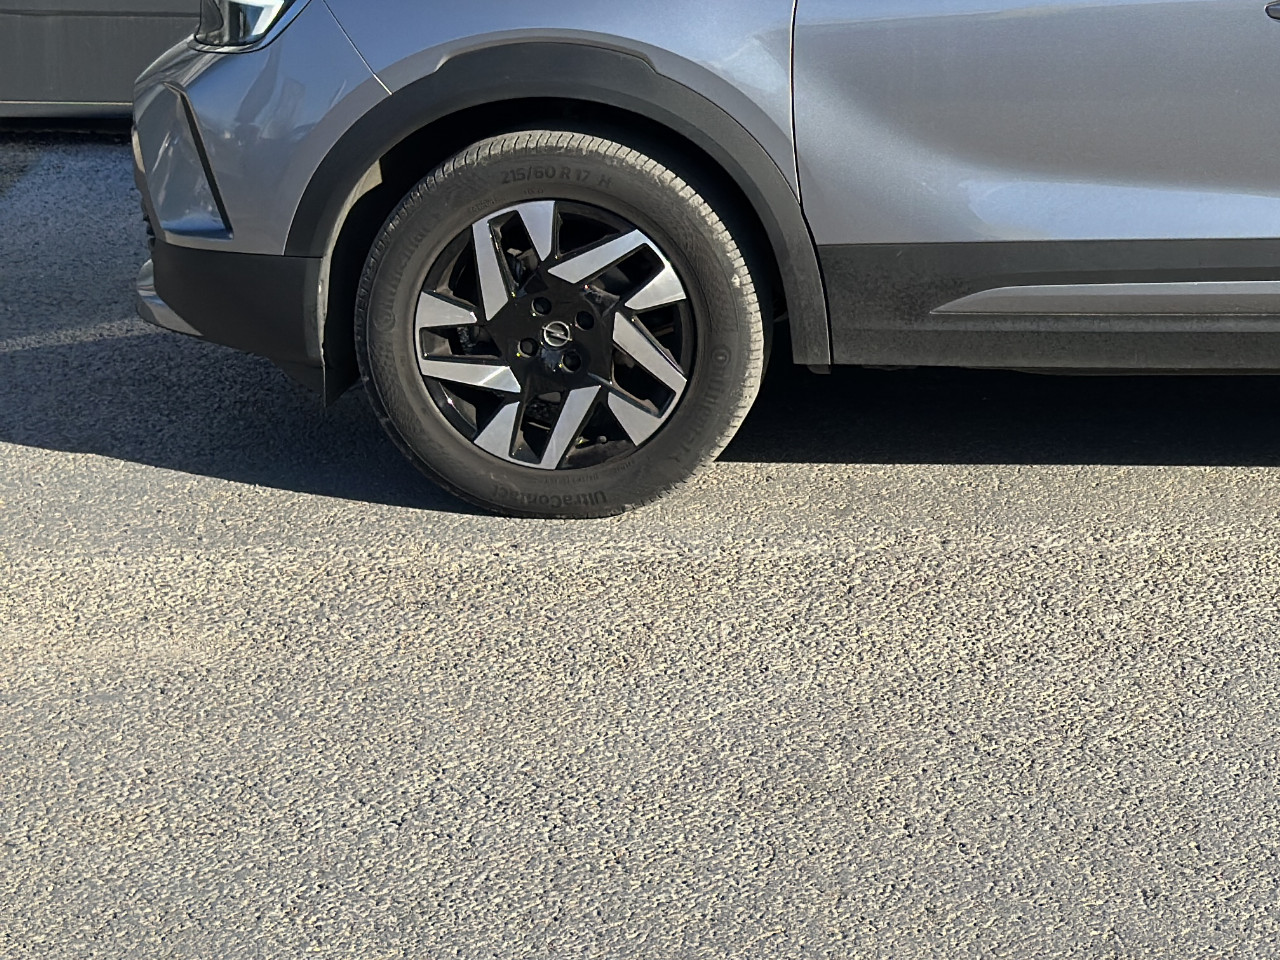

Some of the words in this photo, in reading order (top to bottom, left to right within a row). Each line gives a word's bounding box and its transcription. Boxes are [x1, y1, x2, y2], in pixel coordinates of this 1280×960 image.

[501, 165, 556, 184] 215/60
[560, 166, 571, 180] R
[490, 485, 607, 510] UltraContact
